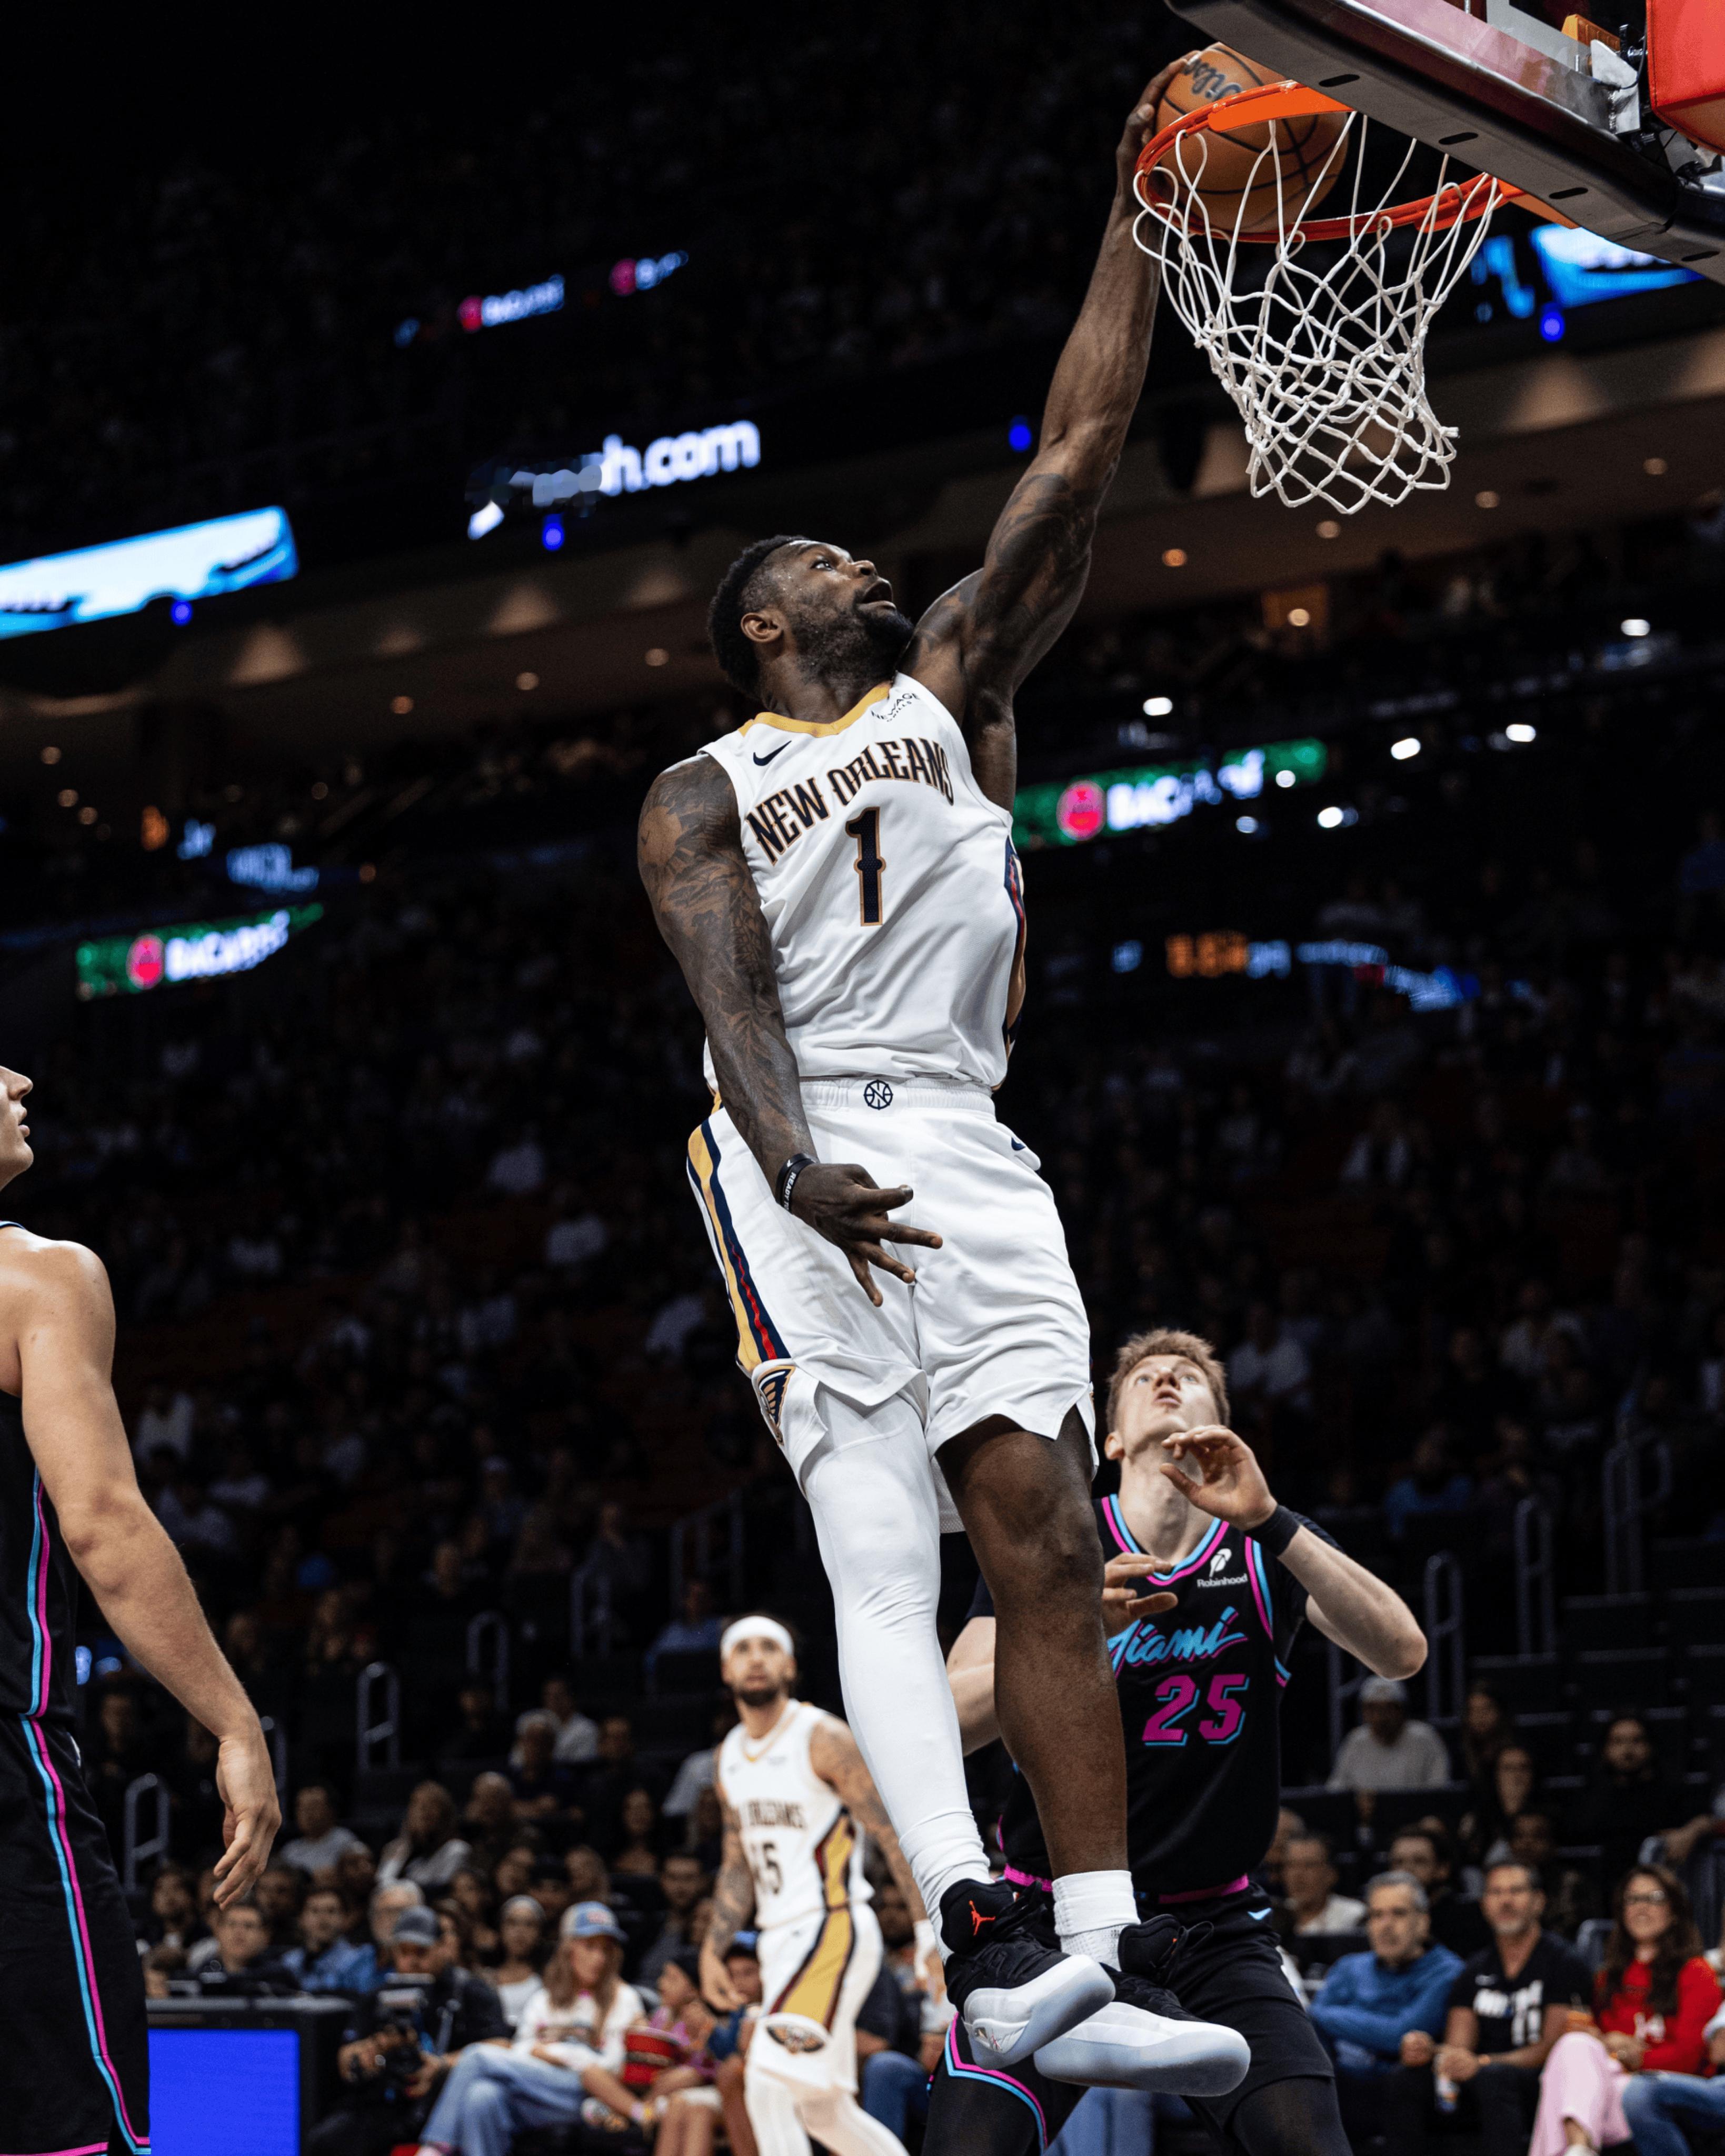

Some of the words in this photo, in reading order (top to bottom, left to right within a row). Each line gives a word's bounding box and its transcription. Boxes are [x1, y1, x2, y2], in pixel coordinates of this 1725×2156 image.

[745, 776, 830, 866] NEW
[827, 737, 954, 806] ORLEANS
[845, 806, 886, 926] 1
[785, 1172, 796, 1201] READY
[1196, 1573, 1248, 1588] Robinhood
[1142, 1674, 1250, 1746] 25
